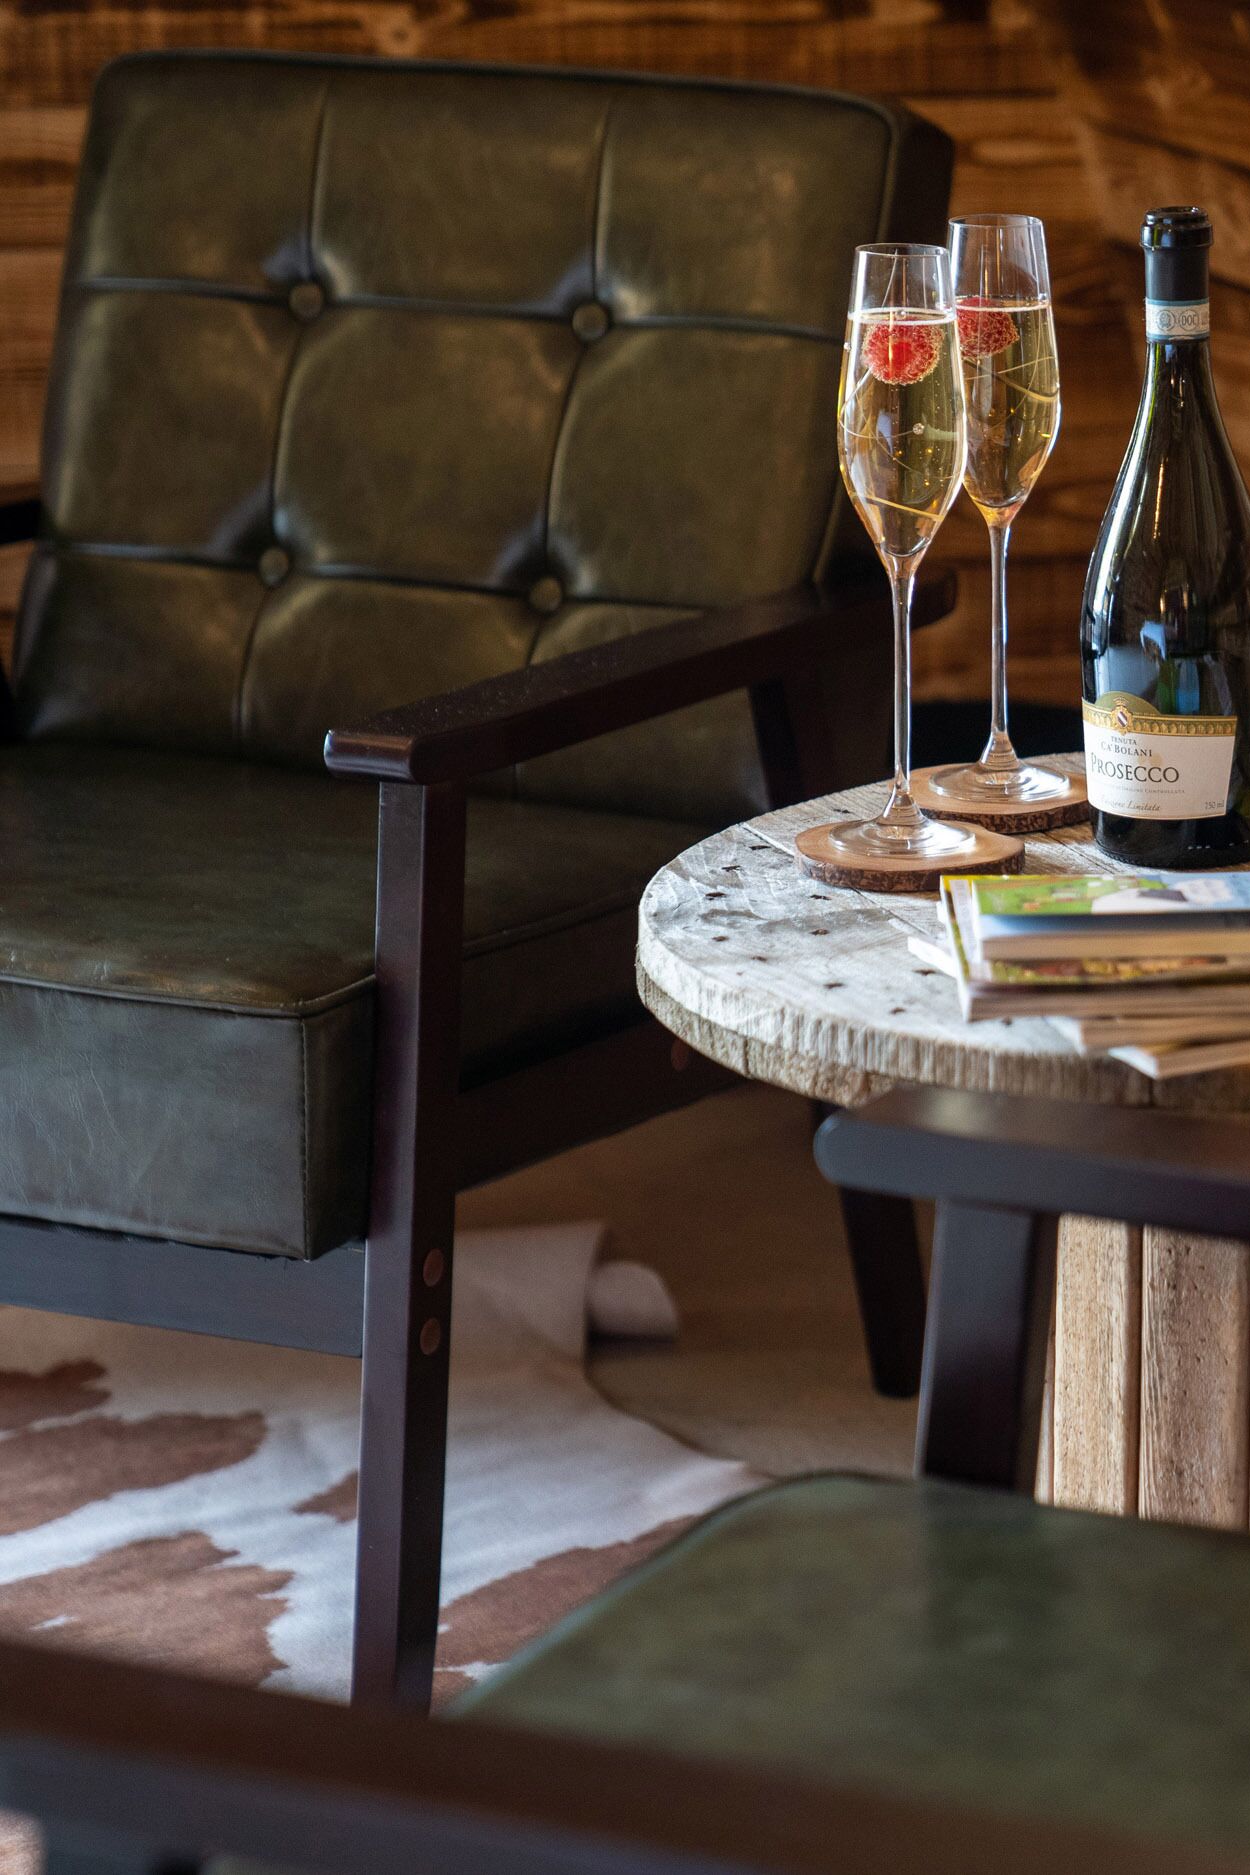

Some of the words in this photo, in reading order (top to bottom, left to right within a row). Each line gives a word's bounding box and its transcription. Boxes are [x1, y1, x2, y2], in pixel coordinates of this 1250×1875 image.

[1181, 314, 1197, 326] DOC
[1110, 735, 1138, 746] TENUTA
[1114, 744, 1153, 758] BOLANI
[1091, 751, 1180, 784] PROSECCO
[1127, 800, 1162, 812] Limitata
